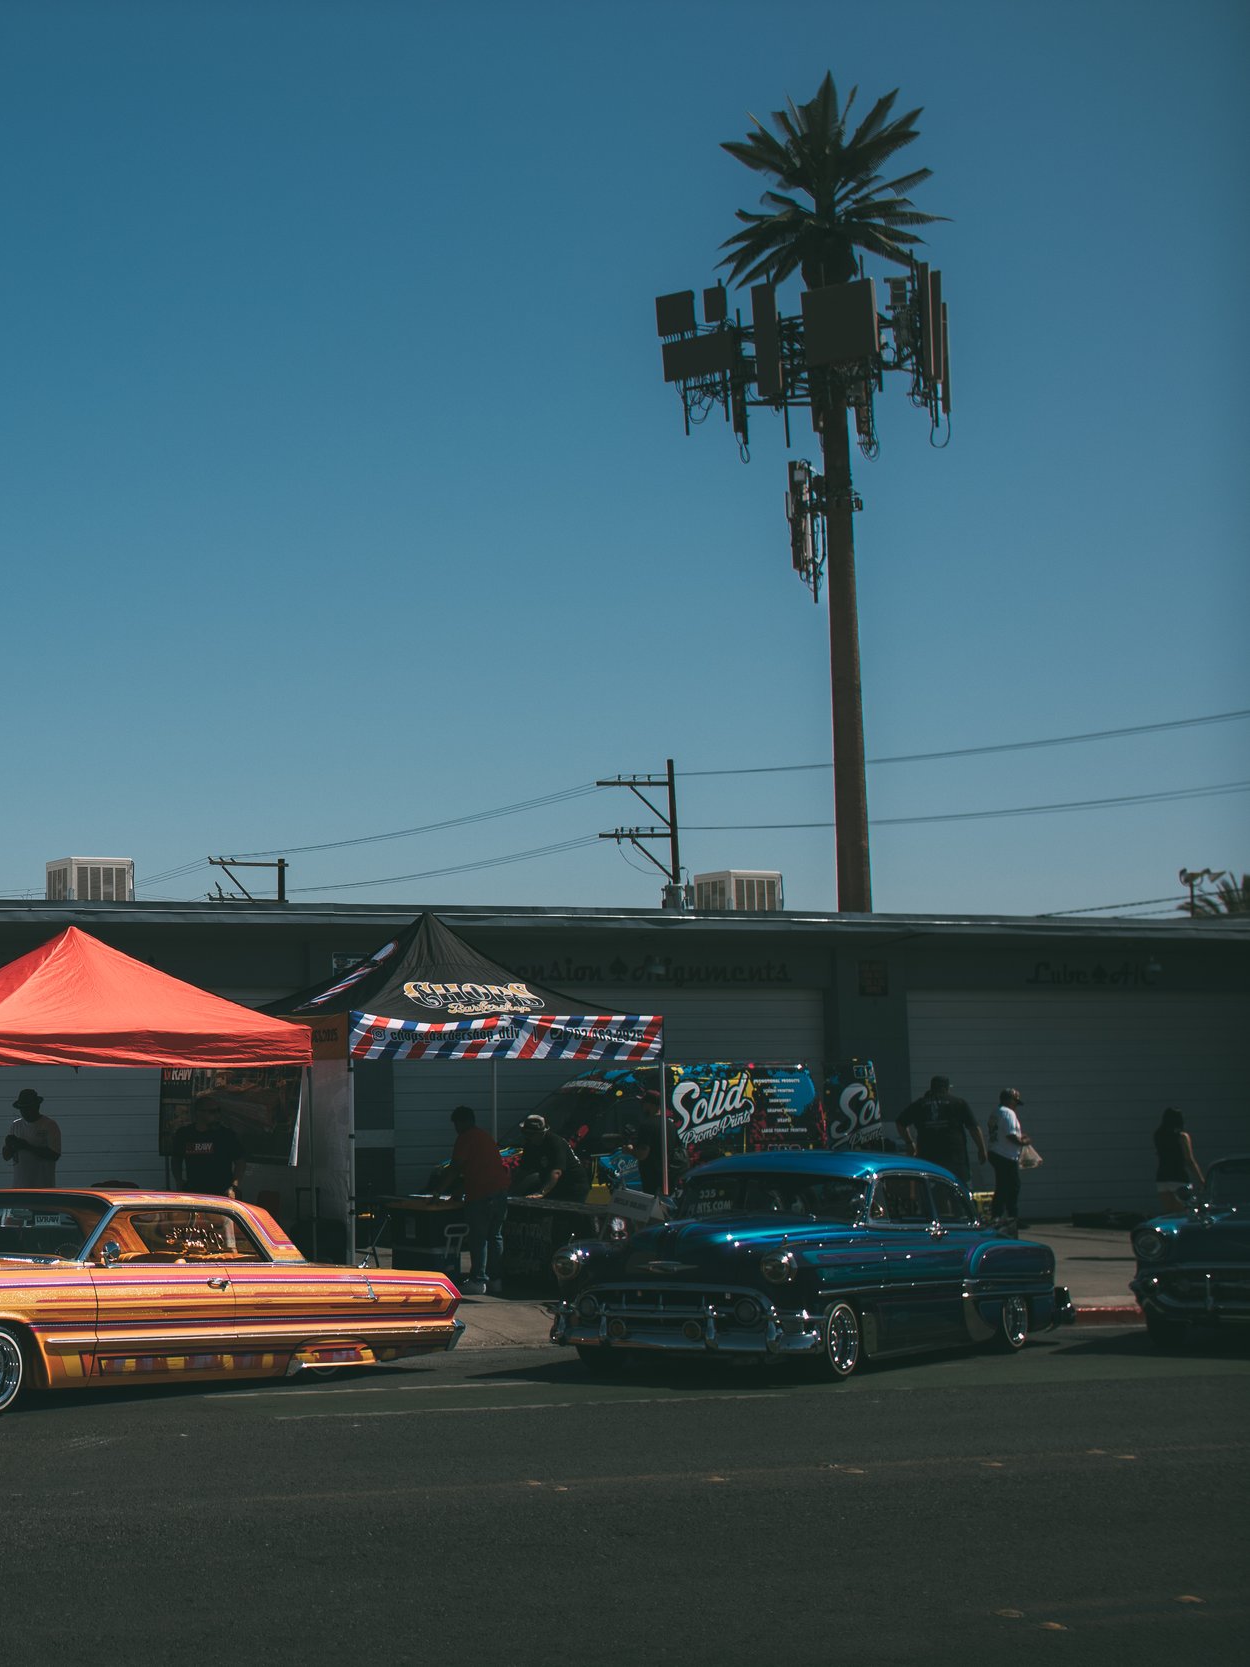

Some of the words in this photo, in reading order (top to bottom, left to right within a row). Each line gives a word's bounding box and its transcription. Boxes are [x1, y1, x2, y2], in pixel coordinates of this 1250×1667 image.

[513, 957, 601, 982] ension
[447, 1001, 532, 1014] Barbershop
[672, 1072, 754, 1138] Solid
